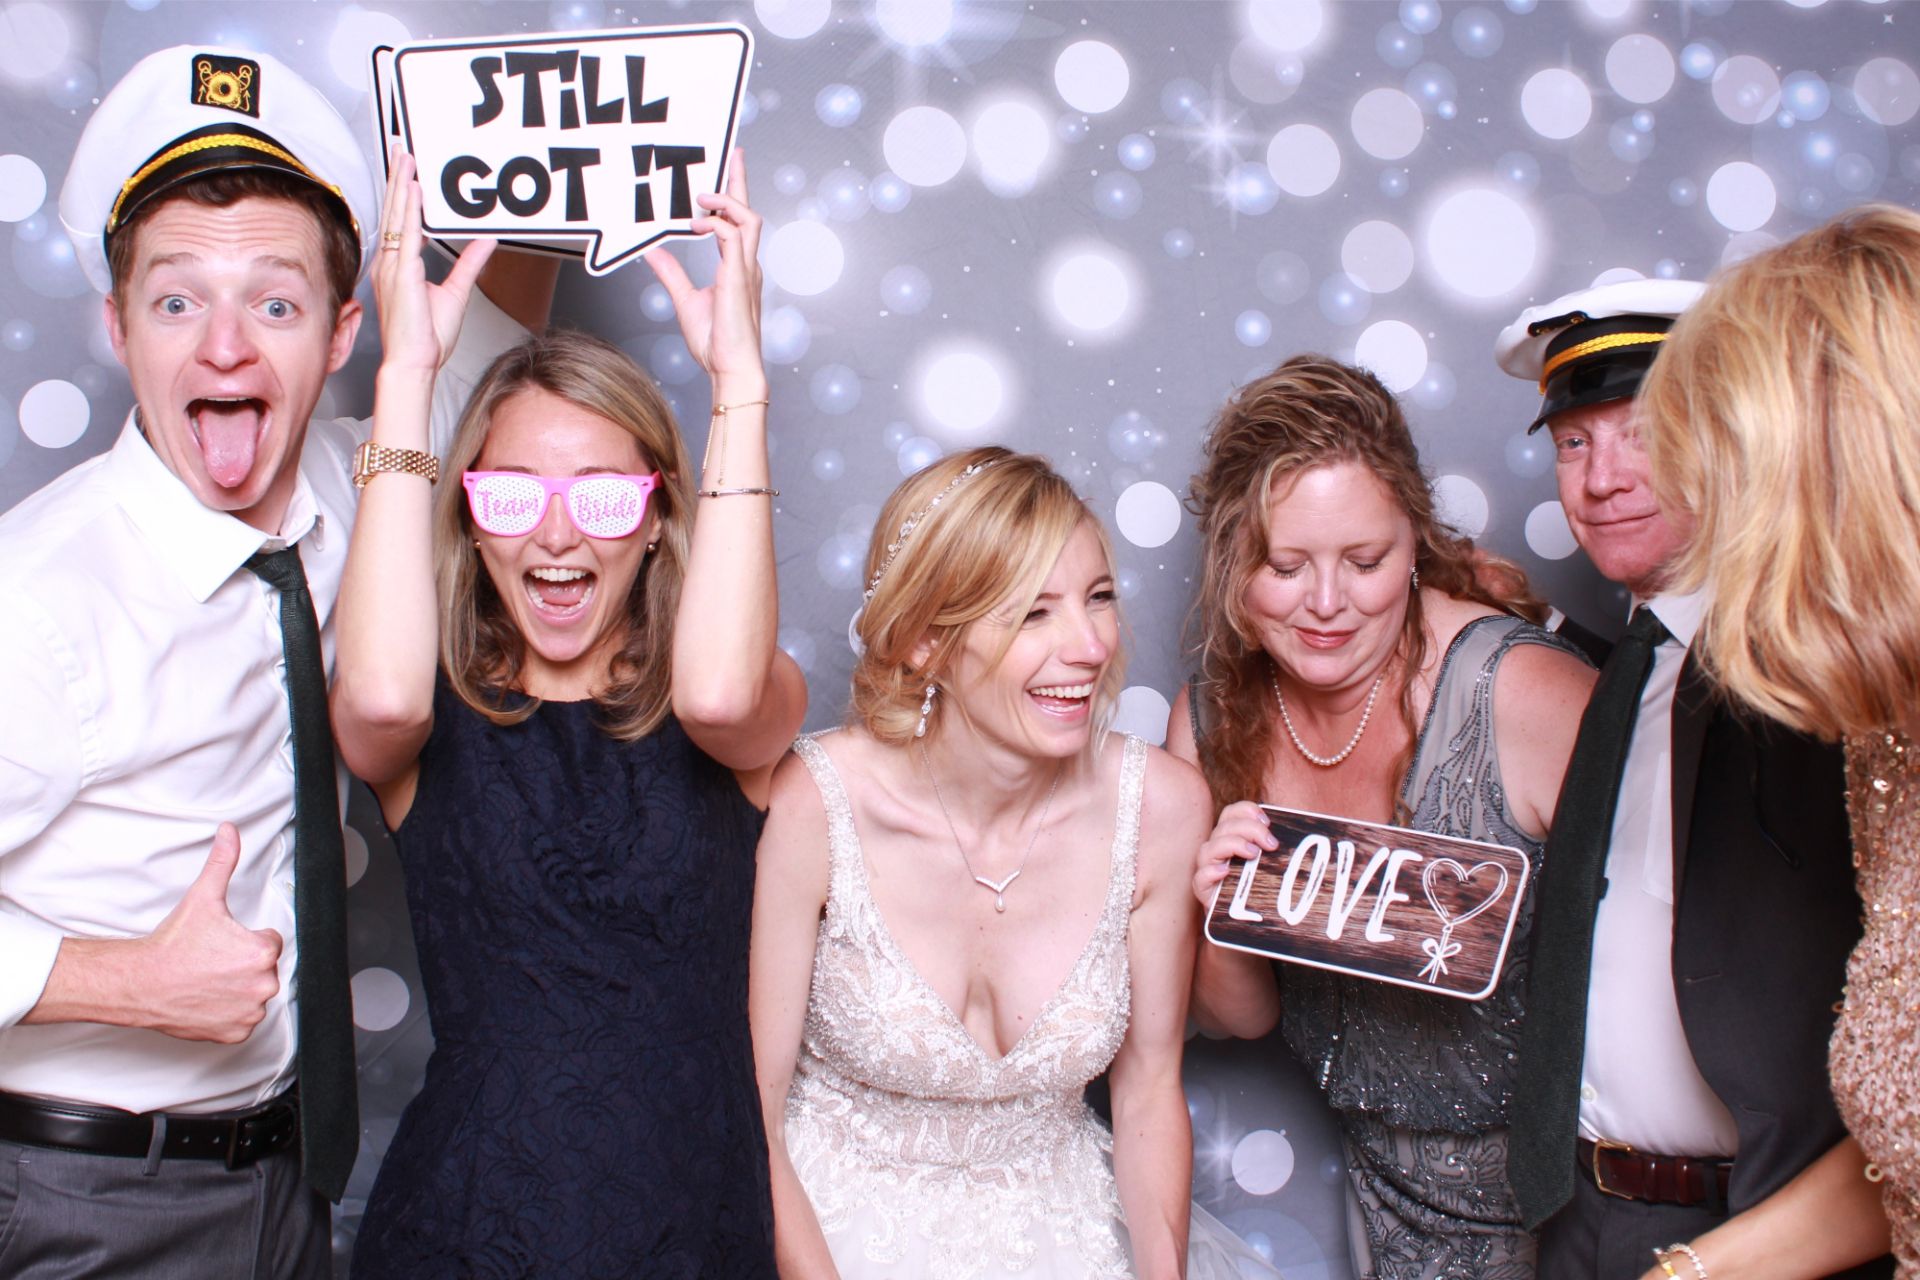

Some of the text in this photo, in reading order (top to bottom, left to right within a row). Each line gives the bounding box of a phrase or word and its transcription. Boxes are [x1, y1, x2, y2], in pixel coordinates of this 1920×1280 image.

[440, 146, 601, 222] GOT
[476, 488, 642, 524] Team Bride
[1228, 833, 1424, 943] LOVE
